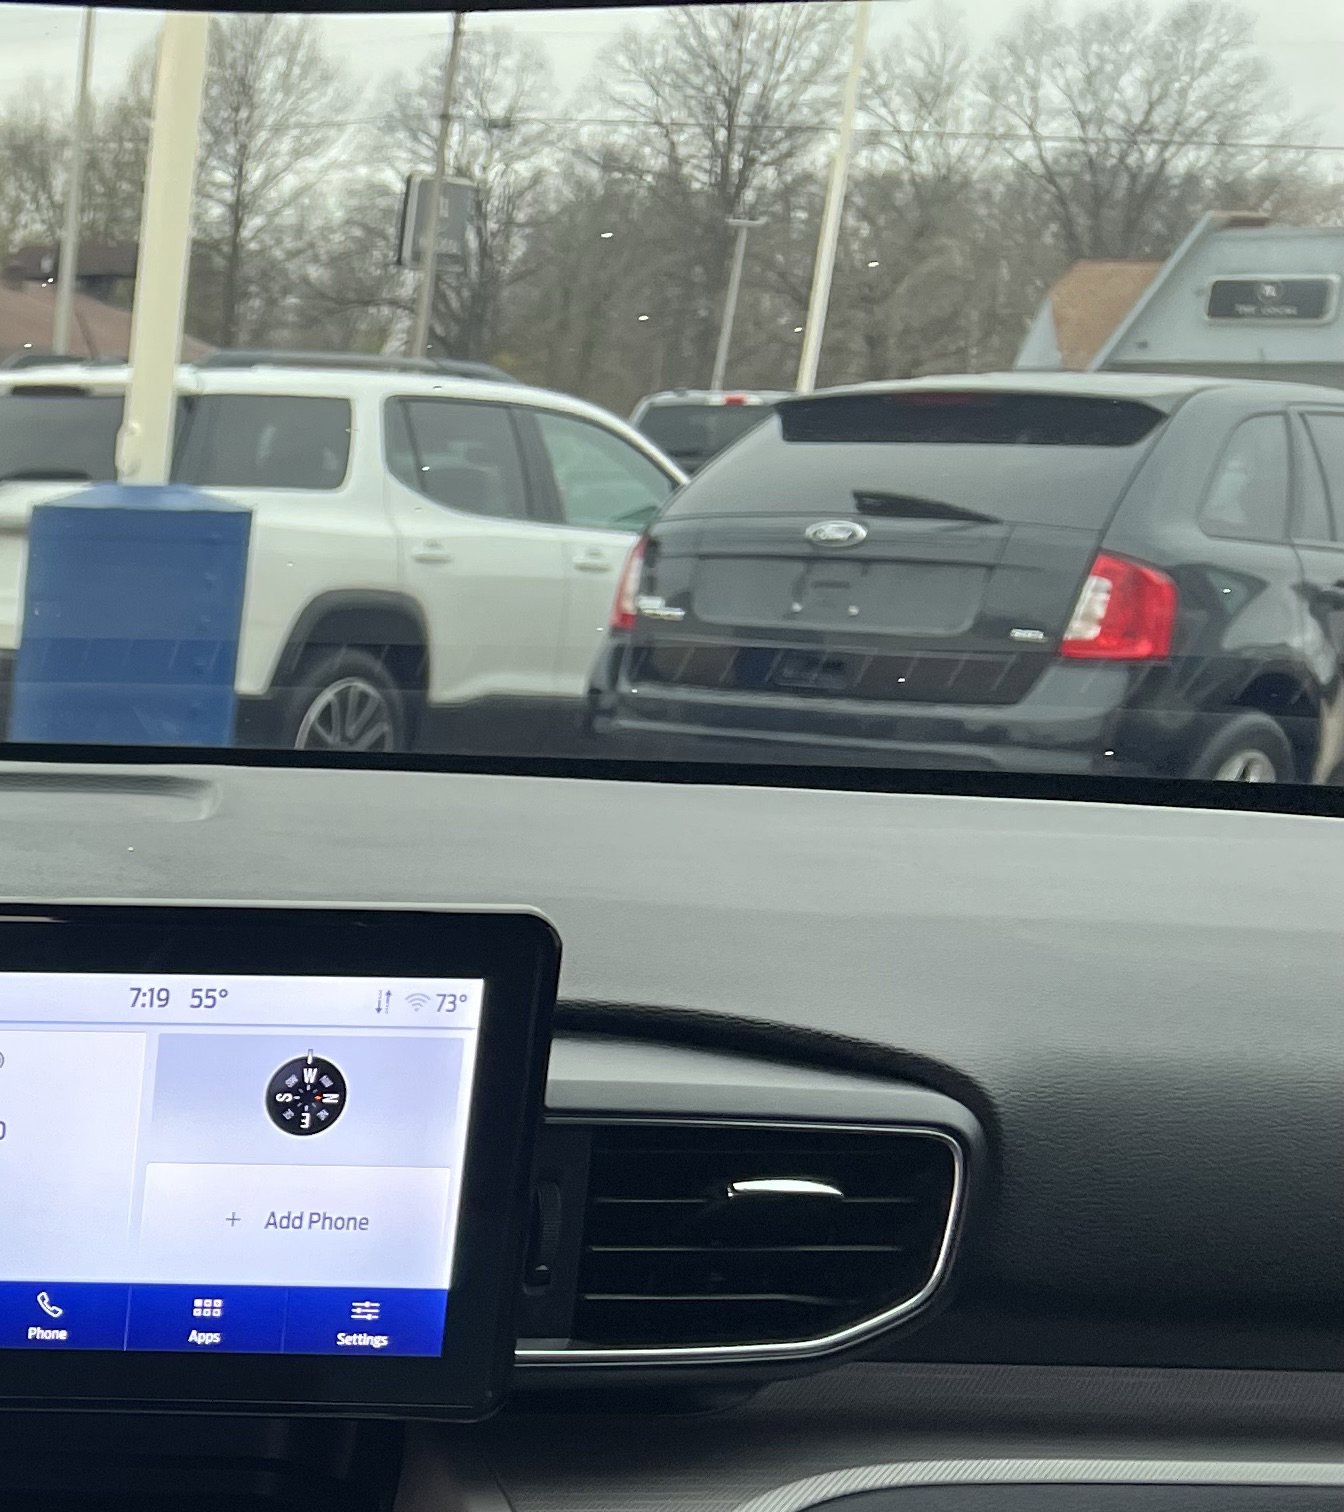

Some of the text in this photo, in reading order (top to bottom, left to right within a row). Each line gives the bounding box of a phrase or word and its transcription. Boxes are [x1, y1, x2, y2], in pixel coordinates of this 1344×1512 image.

[128, 987, 229, 1009] 7:19 55°
[435, 994, 468, 1013] 73°
[303, 1068, 318, 1084] W
[275, 1093, 293, 1102] S
[322, 1093, 340, 1104] N
[300, 1112, 311, 1129] E
[264, 1211, 369, 1231] Add Phone
[27, 1326, 68, 1340] Phone
[188, 1329, 222, 1345] Apps
[336, 1333, 389, 1348] Settings
